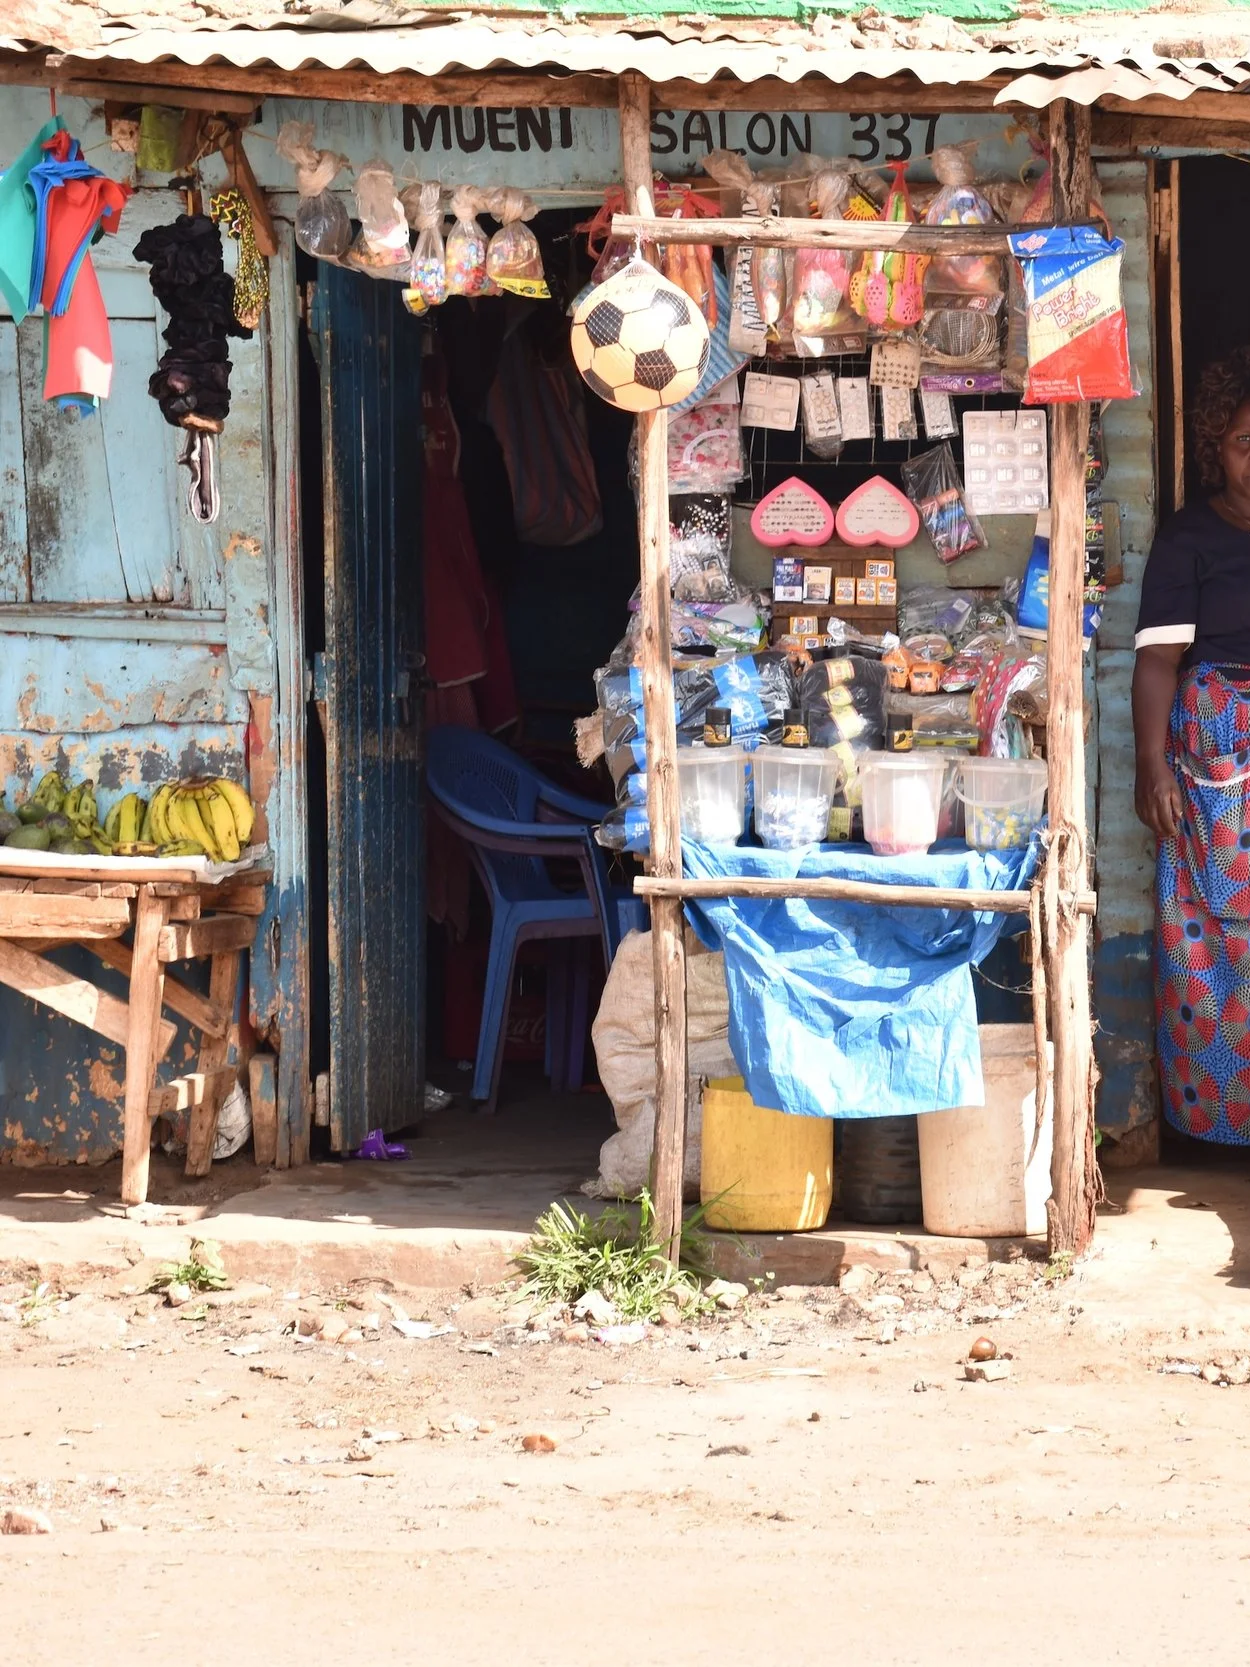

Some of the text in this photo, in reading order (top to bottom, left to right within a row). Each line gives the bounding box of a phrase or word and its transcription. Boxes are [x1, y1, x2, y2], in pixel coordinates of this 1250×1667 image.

[402, 104, 574, 153] MUENI
[649, 110, 812, 157] SALON
[846, 112, 941, 162] 337
[1041, 268, 1065, 287] Metal
[1067, 259, 1086, 273] wire
[1031, 286, 1077, 323] Power
[1052, 290, 1101, 329] Bright
[634, 822, 650, 832] AIR
